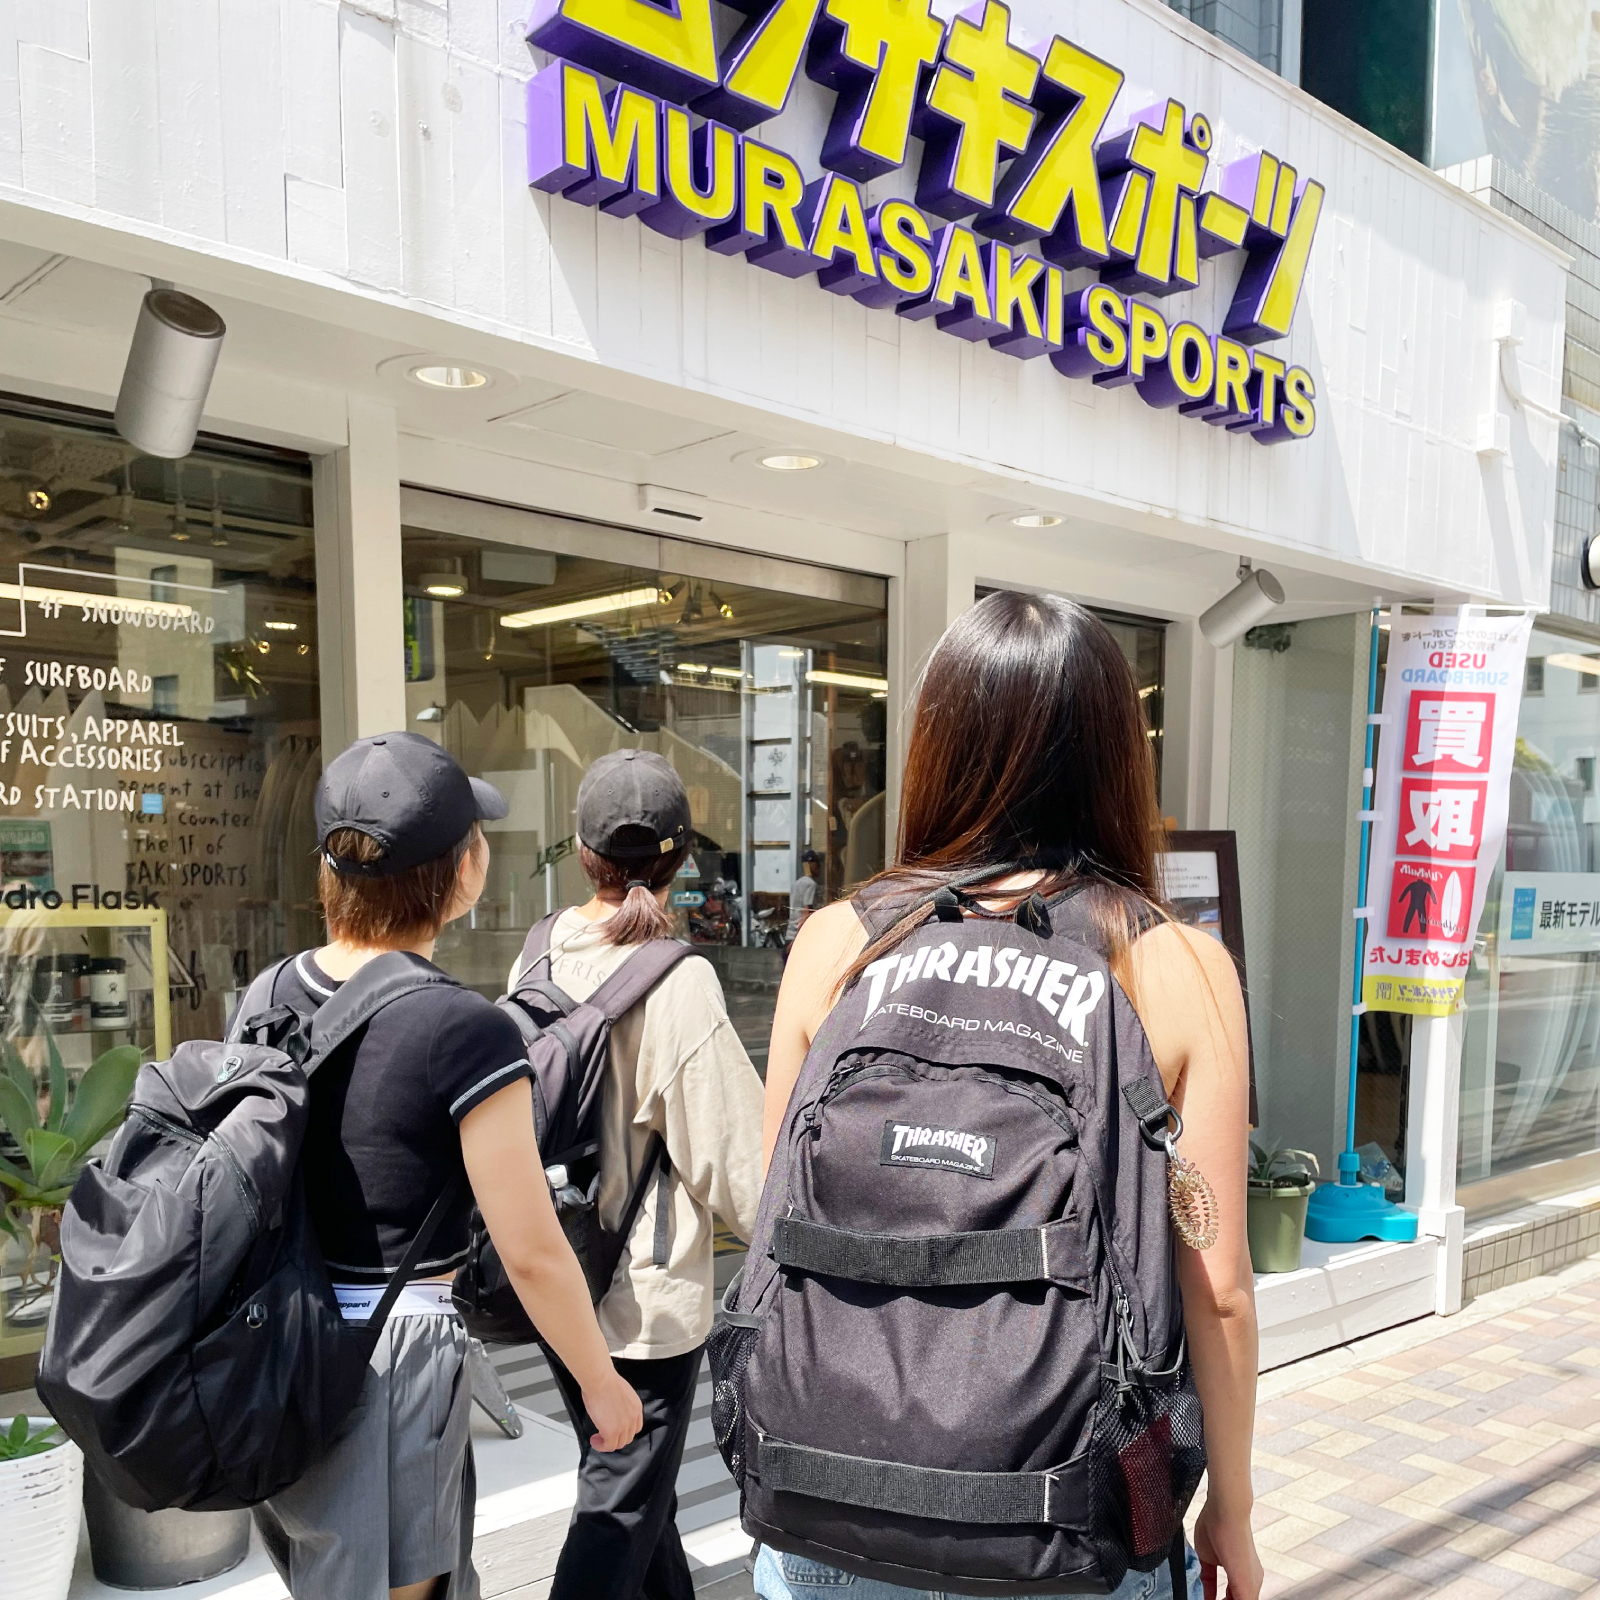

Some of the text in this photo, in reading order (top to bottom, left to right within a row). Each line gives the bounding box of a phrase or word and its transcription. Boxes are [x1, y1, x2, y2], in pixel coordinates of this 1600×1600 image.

[558, 57, 1317, 441] MURASAKI SPORTS
[38, 596, 215, 635] 4F SNOWBOARD
[24, 660, 152, 694] SURFBOARD
[20, 739, 163, 773] ACCESSORIES
[34, 783, 136, 813] STATION
[204, 781, 223, 799] at
[178, 810, 250, 828] counter
[207, 834, 226, 855] of
[182, 861, 247, 888] SPORTS
[0, 882, 161, 910] dro Flask
[1539, 899, 1600, 931] 最新モデル
[860, 941, 1106, 1047] THRASHER
[983, 1018, 1084, 1064] MAGAZINE
[891, 1124, 988, 1167] THRASHER
[890, 1153, 982, 1173] SKATEBOARD MAGAZINE
